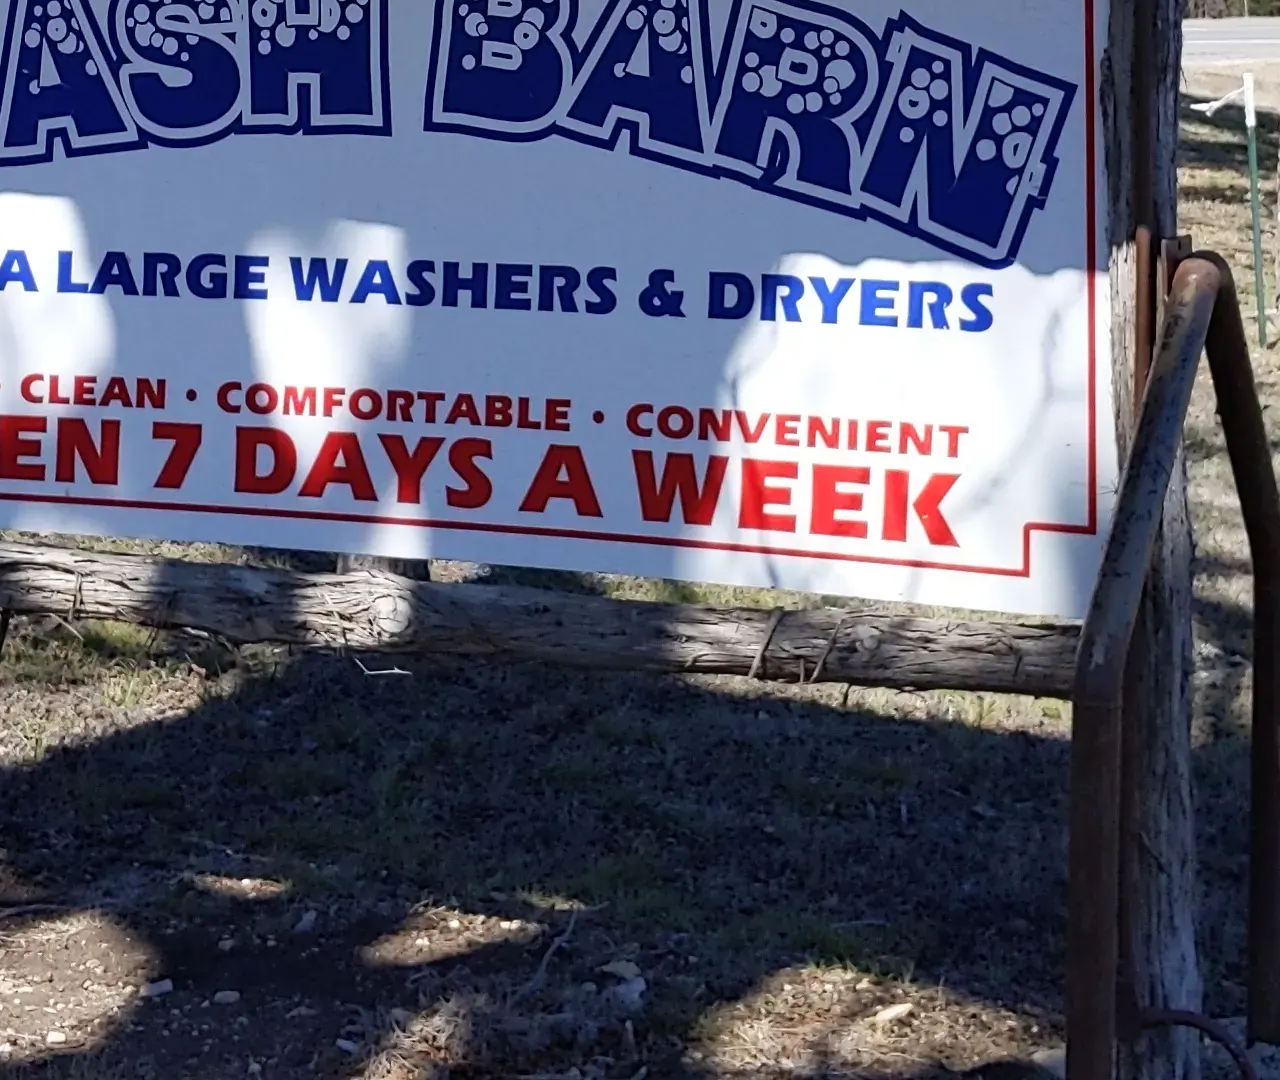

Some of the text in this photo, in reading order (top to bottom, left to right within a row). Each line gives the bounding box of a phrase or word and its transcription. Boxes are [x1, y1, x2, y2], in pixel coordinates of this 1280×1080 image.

[57, 251, 270, 300] LARGE
[289, 256, 617, 315] WASHERS
[638, 269, 686, 318] &
[708, 271, 994, 332] DRYERS
[21, 373, 166, 409] CLEAN
[217, 381, 571, 432] COMFORTABLE
[626, 403, 969, 458] CONVENIENT
[152, 421, 202, 489] 7
[234, 426, 493, 509] DAYS
[518, 444, 603, 518] A
[632, 449, 961, 548] WEEK
